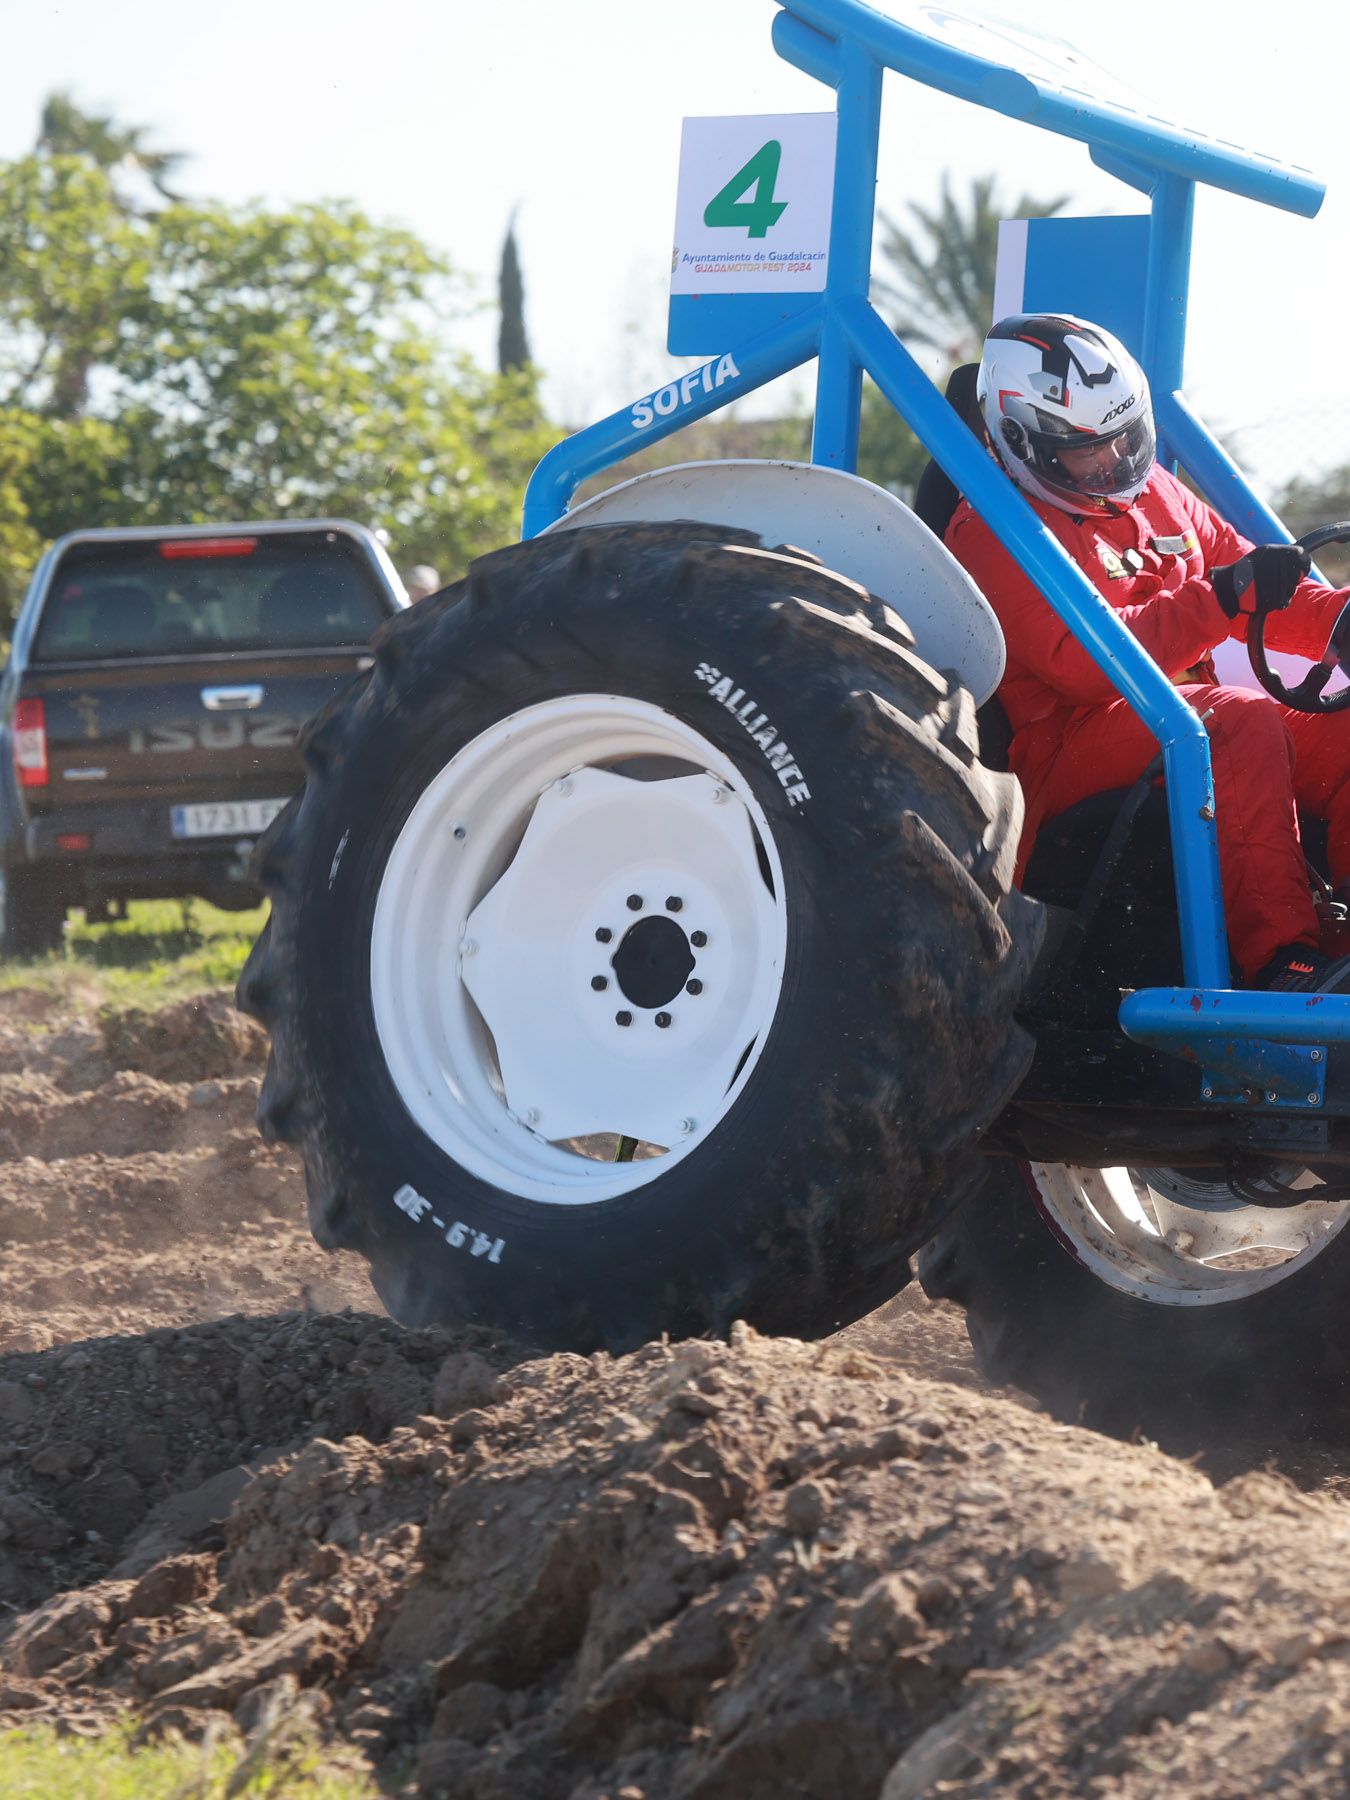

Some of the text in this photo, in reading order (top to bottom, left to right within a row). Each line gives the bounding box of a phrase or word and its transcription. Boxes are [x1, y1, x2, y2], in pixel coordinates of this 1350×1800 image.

[703, 139, 789, 238] 4
[682, 252, 751, 265] Ayuntamiento
[753, 252, 766, 261] de
[694, 262, 812, 273] GUADAMOTOR FEST 2024
[631, 353, 741, 430] SOFIA
[129, 714, 296, 753] ISUZ
[707, 676, 812, 806] ALLIANCE
